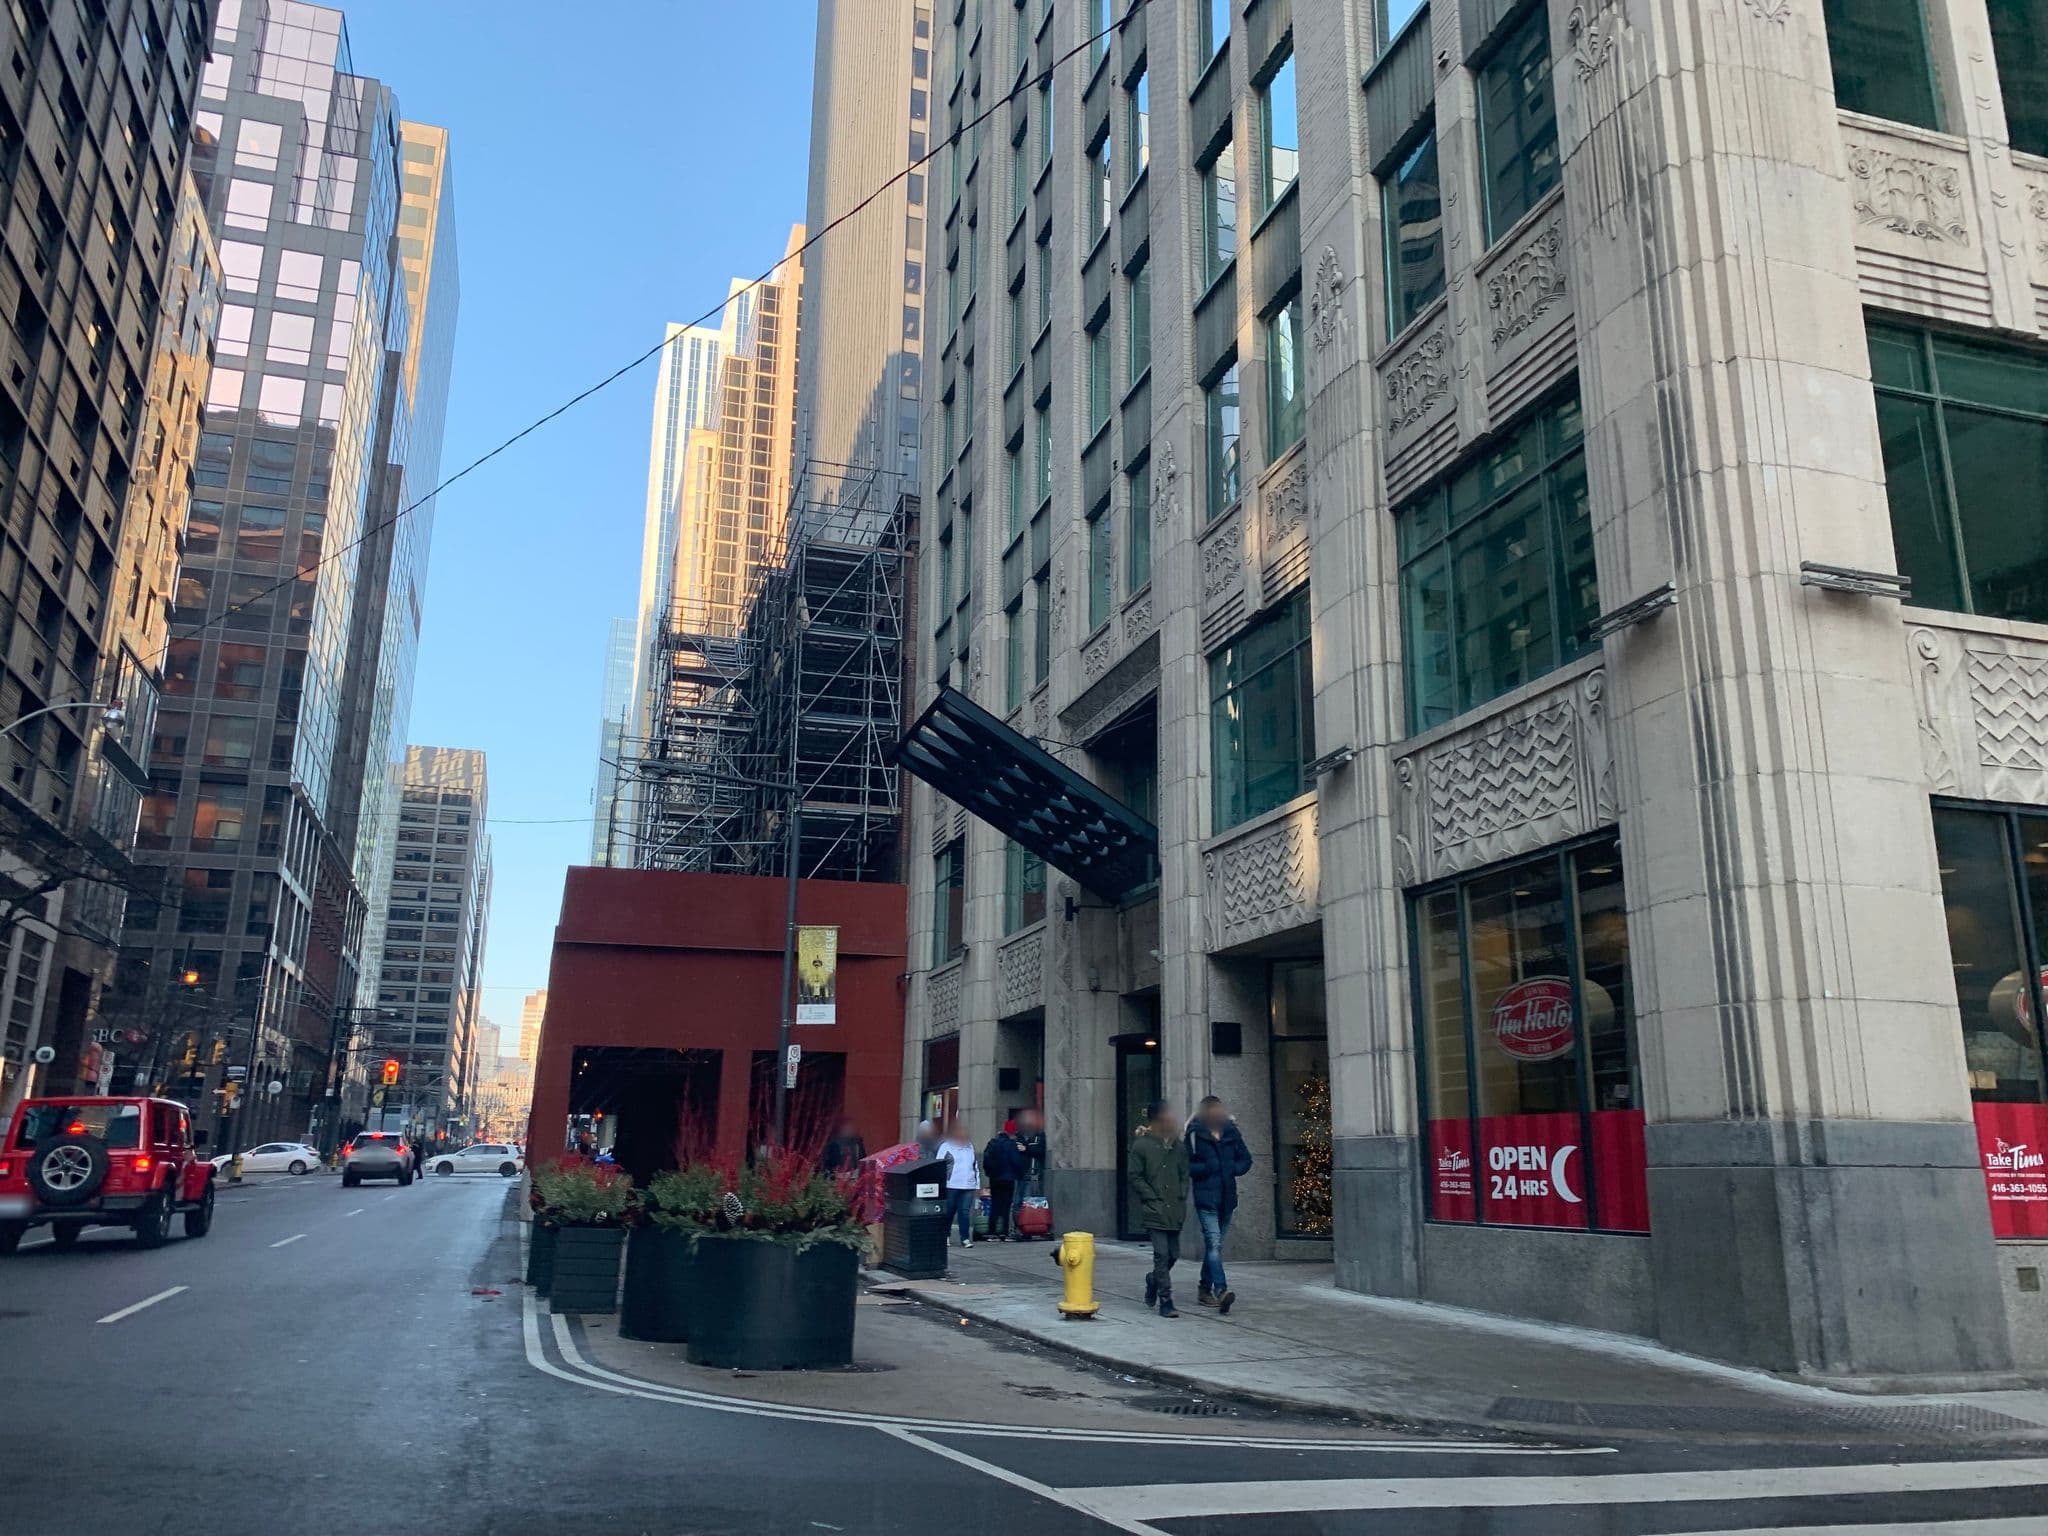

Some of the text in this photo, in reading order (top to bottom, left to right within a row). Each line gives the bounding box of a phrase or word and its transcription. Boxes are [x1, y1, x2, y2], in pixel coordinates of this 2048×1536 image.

[1494, 1000, 1573, 1036] Tim Horto
[91, 1028, 125, 1043] SBC
[1450, 1151, 1471, 1172] Tims
[1488, 1145, 1548, 1171] OPEN
[1985, 1144, 2044, 1171] Take Tims
[1490, 1175, 1549, 1200] 24 HRS
[1991, 1183, 2048, 1193] 416-363-1055
